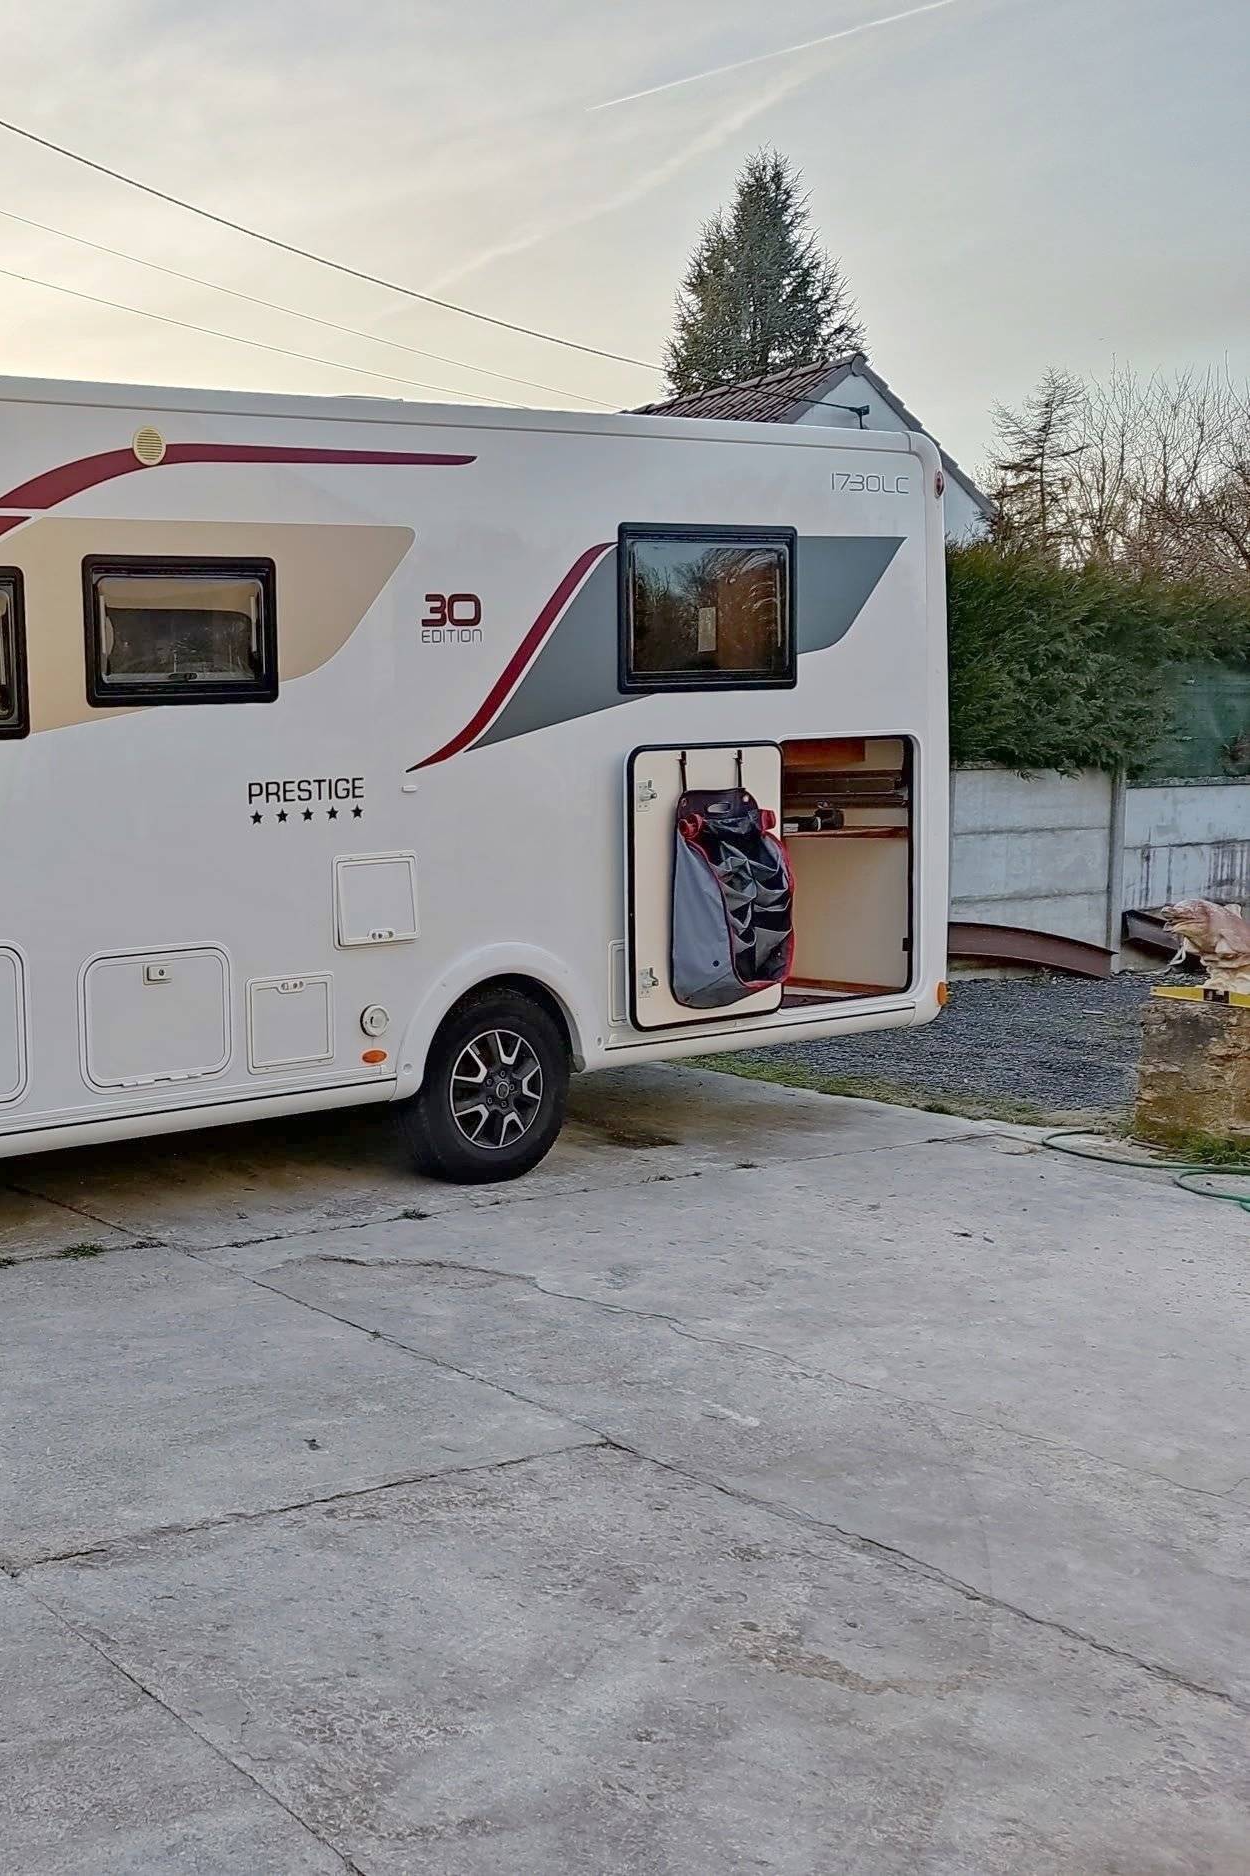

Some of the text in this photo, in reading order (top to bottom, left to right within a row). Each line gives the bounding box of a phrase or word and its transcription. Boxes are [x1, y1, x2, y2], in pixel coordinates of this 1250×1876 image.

[421, 593, 482, 627] 30
[421, 629, 483, 643] EDITION
[248, 777, 364, 804] PRESTIGE
